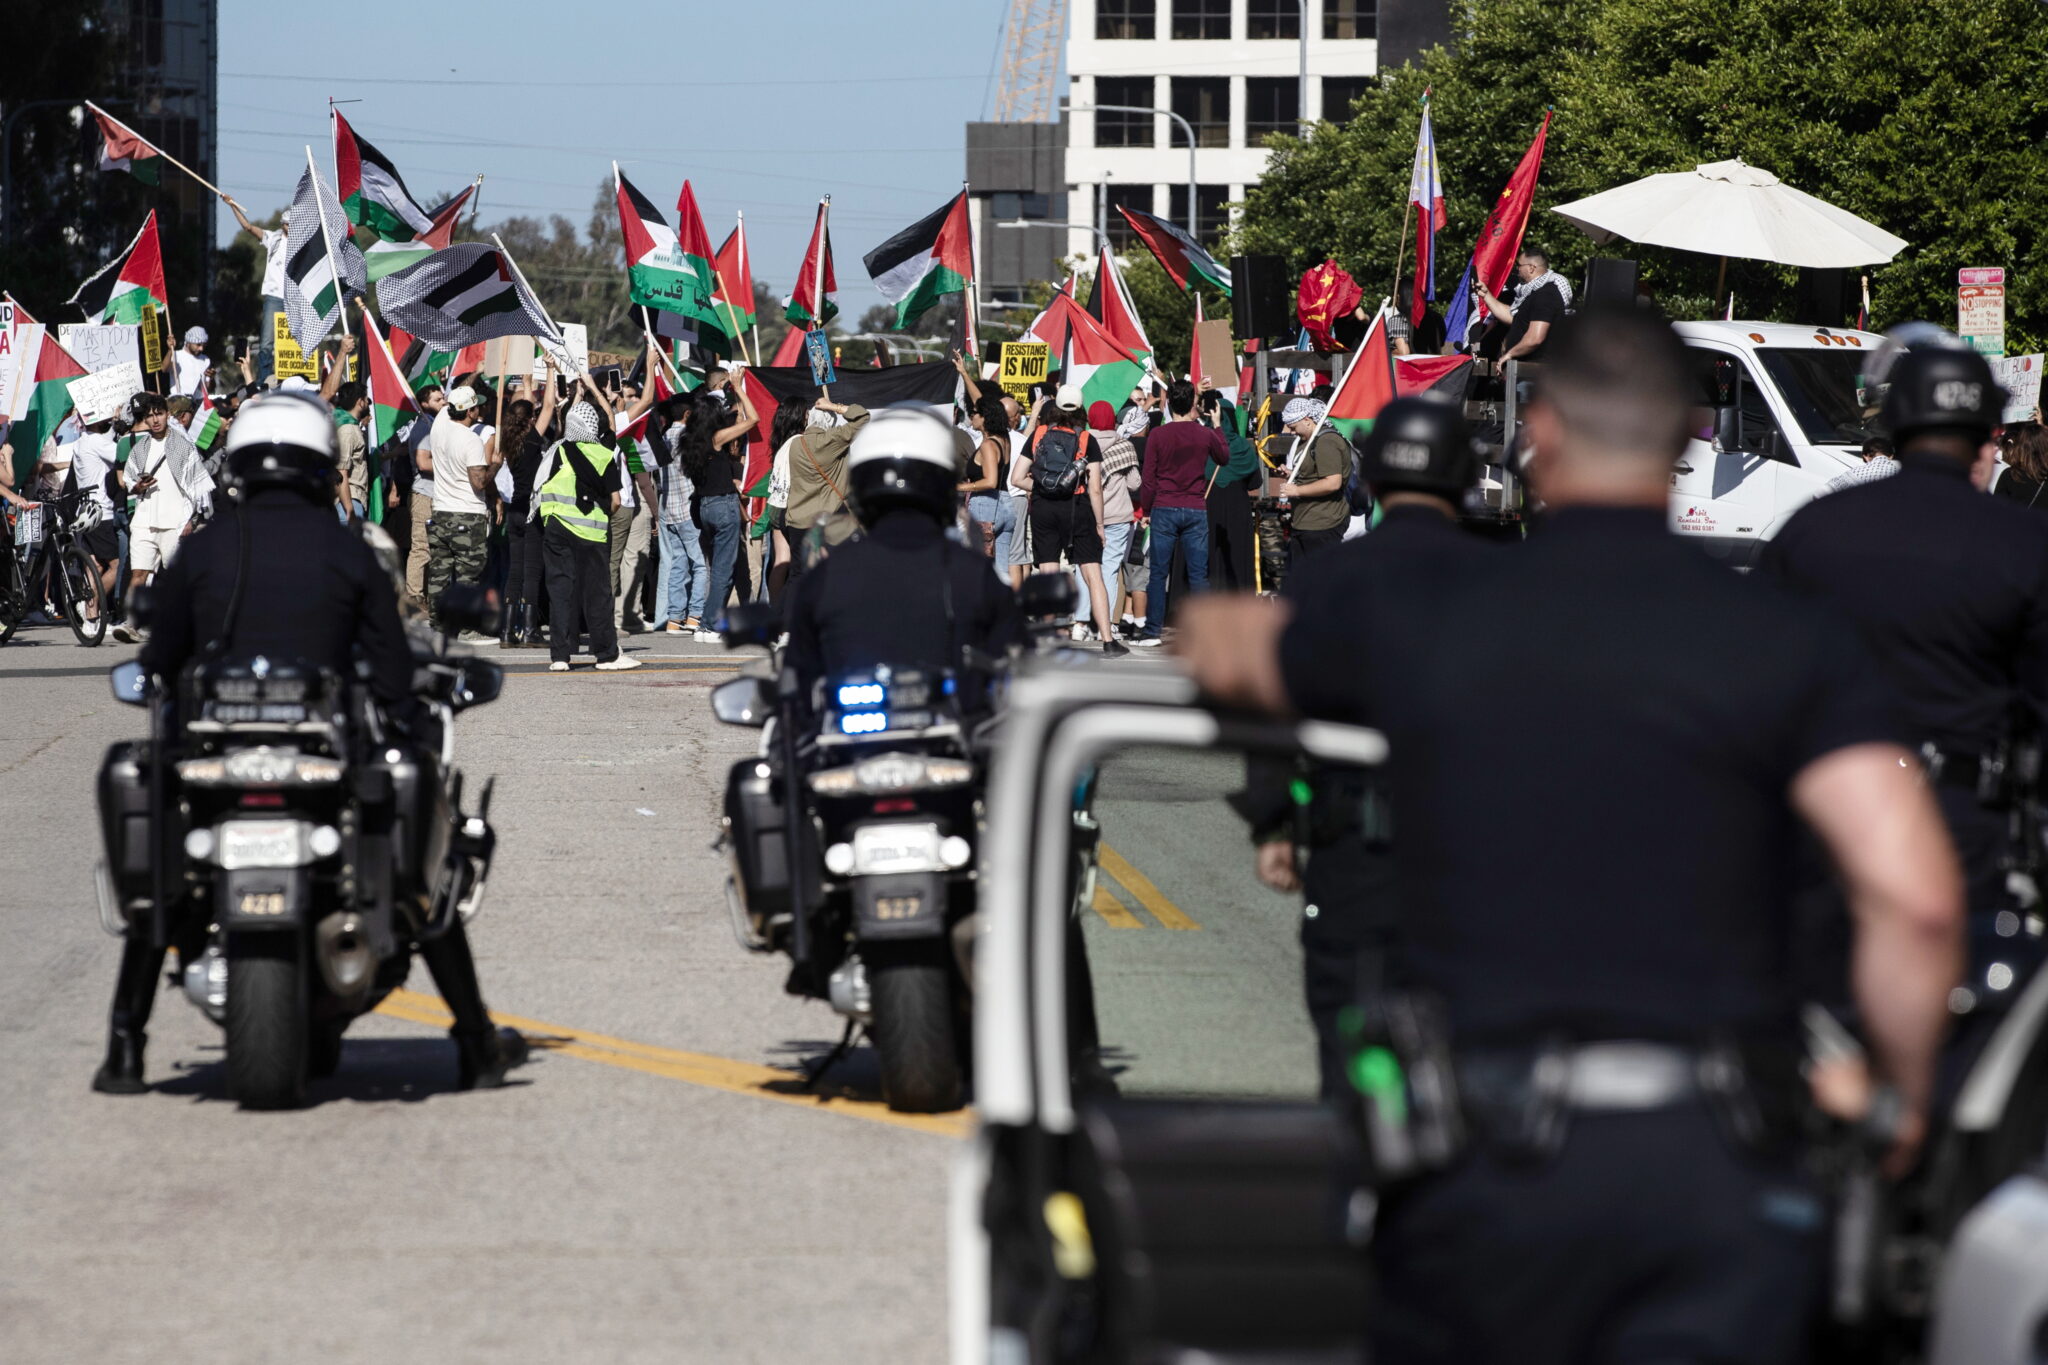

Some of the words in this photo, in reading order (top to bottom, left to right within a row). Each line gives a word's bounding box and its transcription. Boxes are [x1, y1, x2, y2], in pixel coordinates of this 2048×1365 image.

[1960, 297, 1974, 310] NO
[1975, 299, 2002, 308] STOPPING
[278, 350, 294, 360] WHEN
[1006, 345, 1047, 356] RESISTANCE
[278, 361, 289, 369] ARE
[1005, 357, 1017, 376] IS
[1021, 357, 1045, 376] NOT
